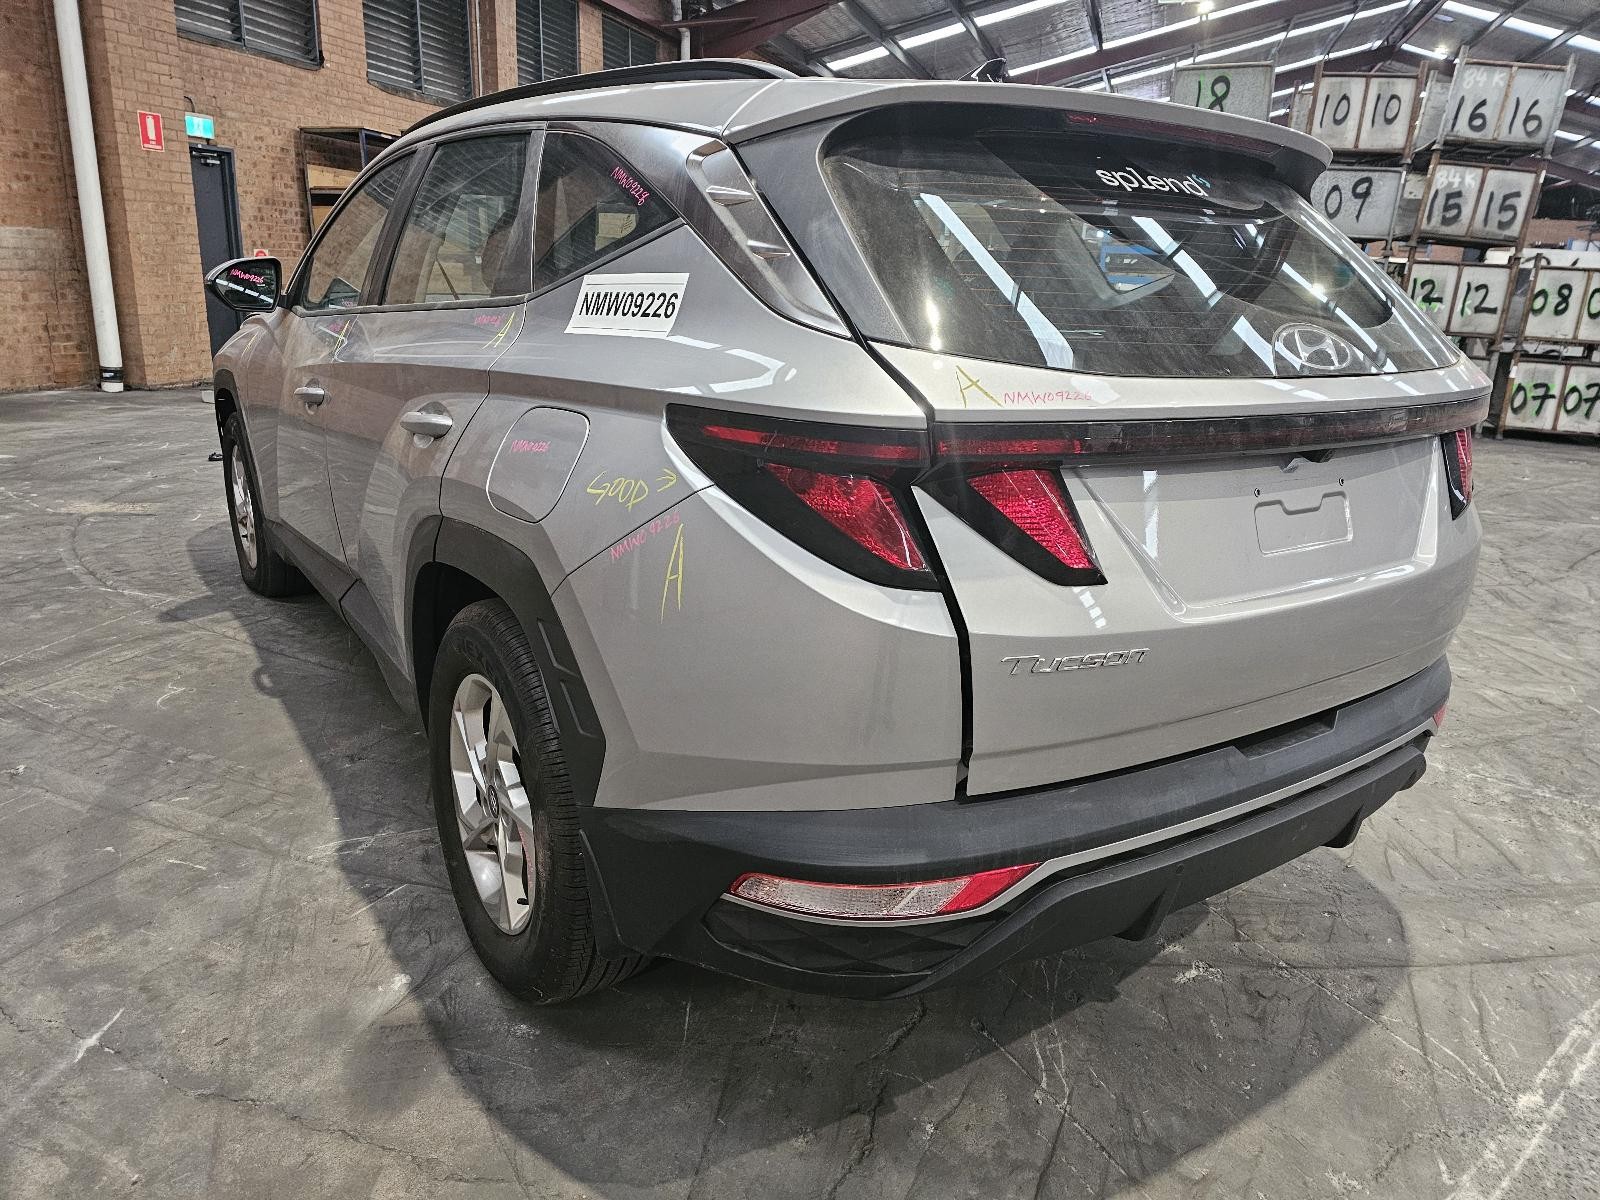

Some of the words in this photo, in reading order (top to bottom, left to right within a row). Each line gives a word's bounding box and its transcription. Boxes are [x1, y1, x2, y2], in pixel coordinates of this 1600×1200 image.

[1195, 75, 1231, 112] 18
[1319, 93, 1351, 128] 10
[1371, 93, 1401, 128] 10
[1451, 95, 1487, 132] 16
[1508, 97, 1542, 138] 16
[1096, 166, 1209, 199] splend
[1324, 176, 1373, 223] 09
[1427, 188, 1463, 226] 15
[1483, 190, 1522, 231] 15
[579, 291, 679, 319] NMW09226
[1411, 277, 1444, 305] 12
[1461, 281, 1498, 317] 12
[1531, 283, 1573, 316] 08
[481, 310, 516, 350] A
[955, 365, 1004, 409] A
[1003, 390, 1092, 405] NMW09226
[1510, 382, 1556, 417] 07
[1564, 382, 1600, 420] 07
[660, 523, 685, 625] A
